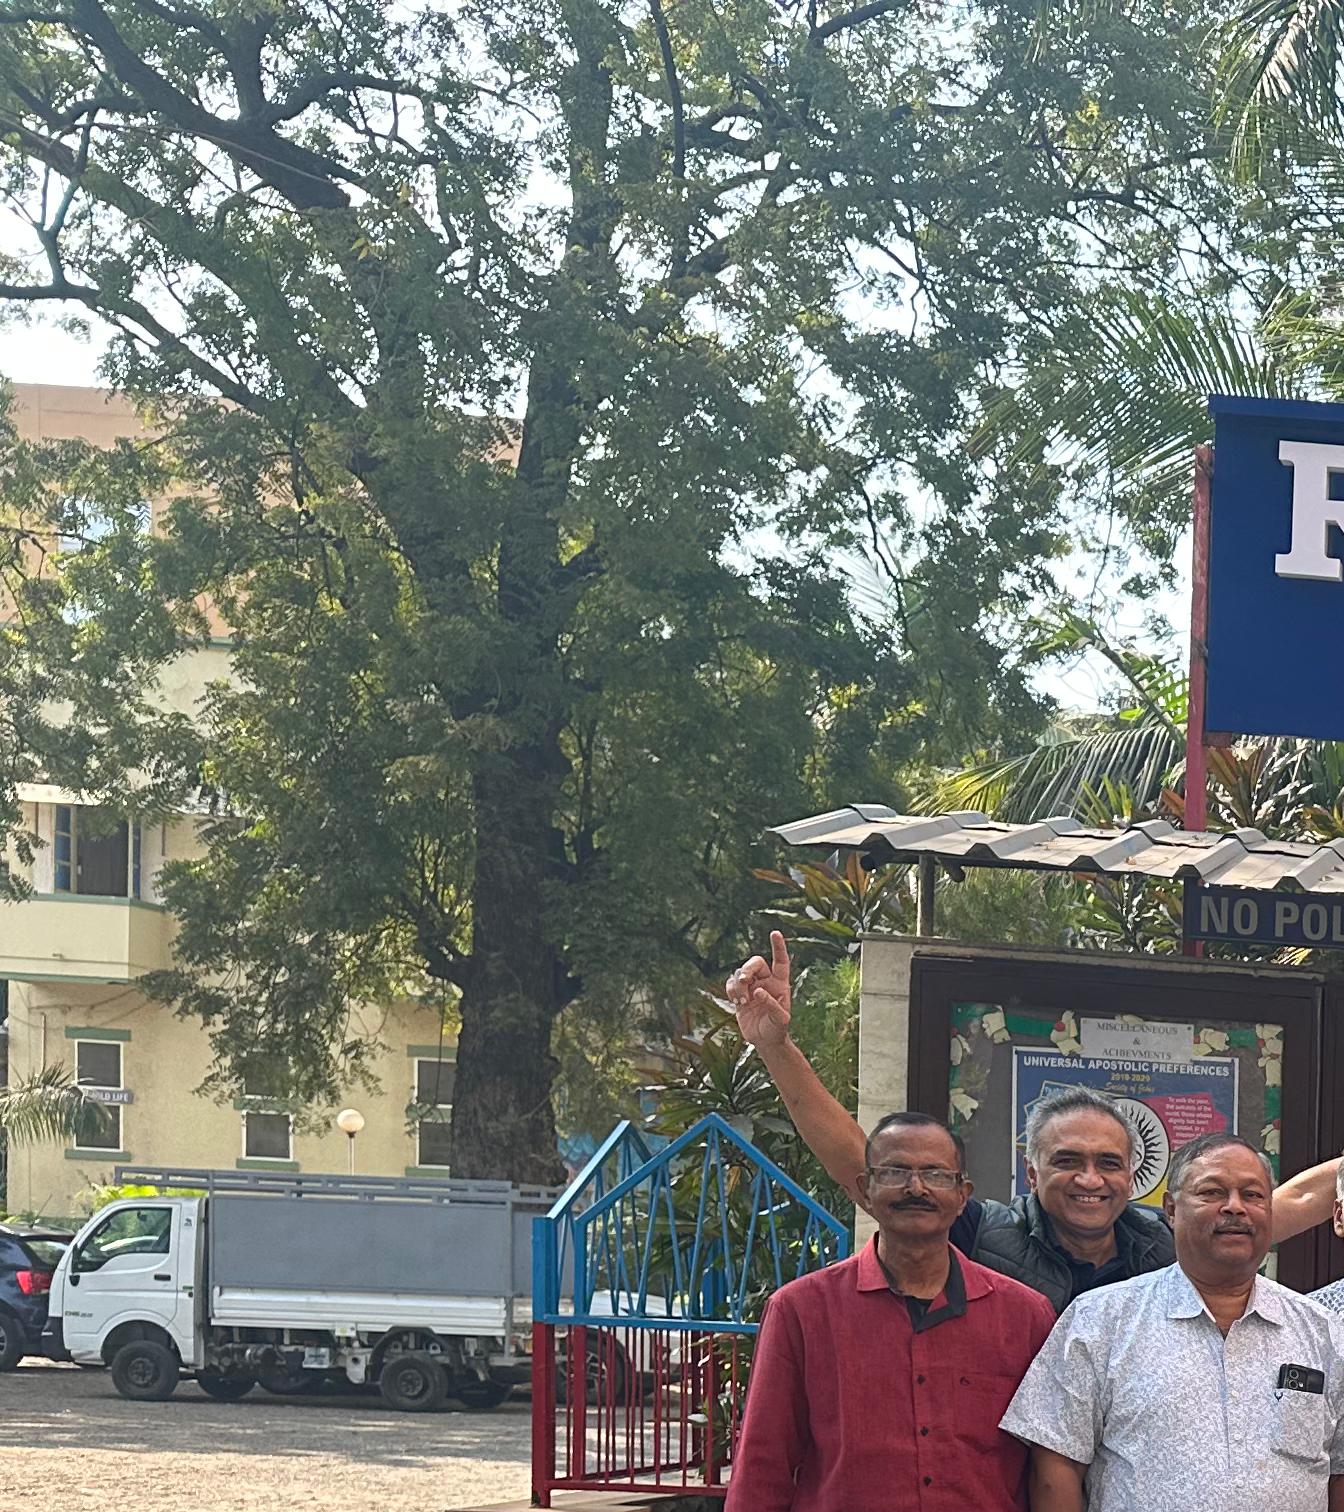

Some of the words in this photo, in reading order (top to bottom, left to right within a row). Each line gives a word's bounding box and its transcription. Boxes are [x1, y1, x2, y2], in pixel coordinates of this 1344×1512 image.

[1200, 895, 1259, 935] NO
[1132, 1038, 1142, 1046] &
[1023, 1055, 1086, 1069] UNIVERSAL
[1087, 1060, 1150, 1073] APOSTOLIC
[1152, 1063, 1230, 1077] PREFERENCES
